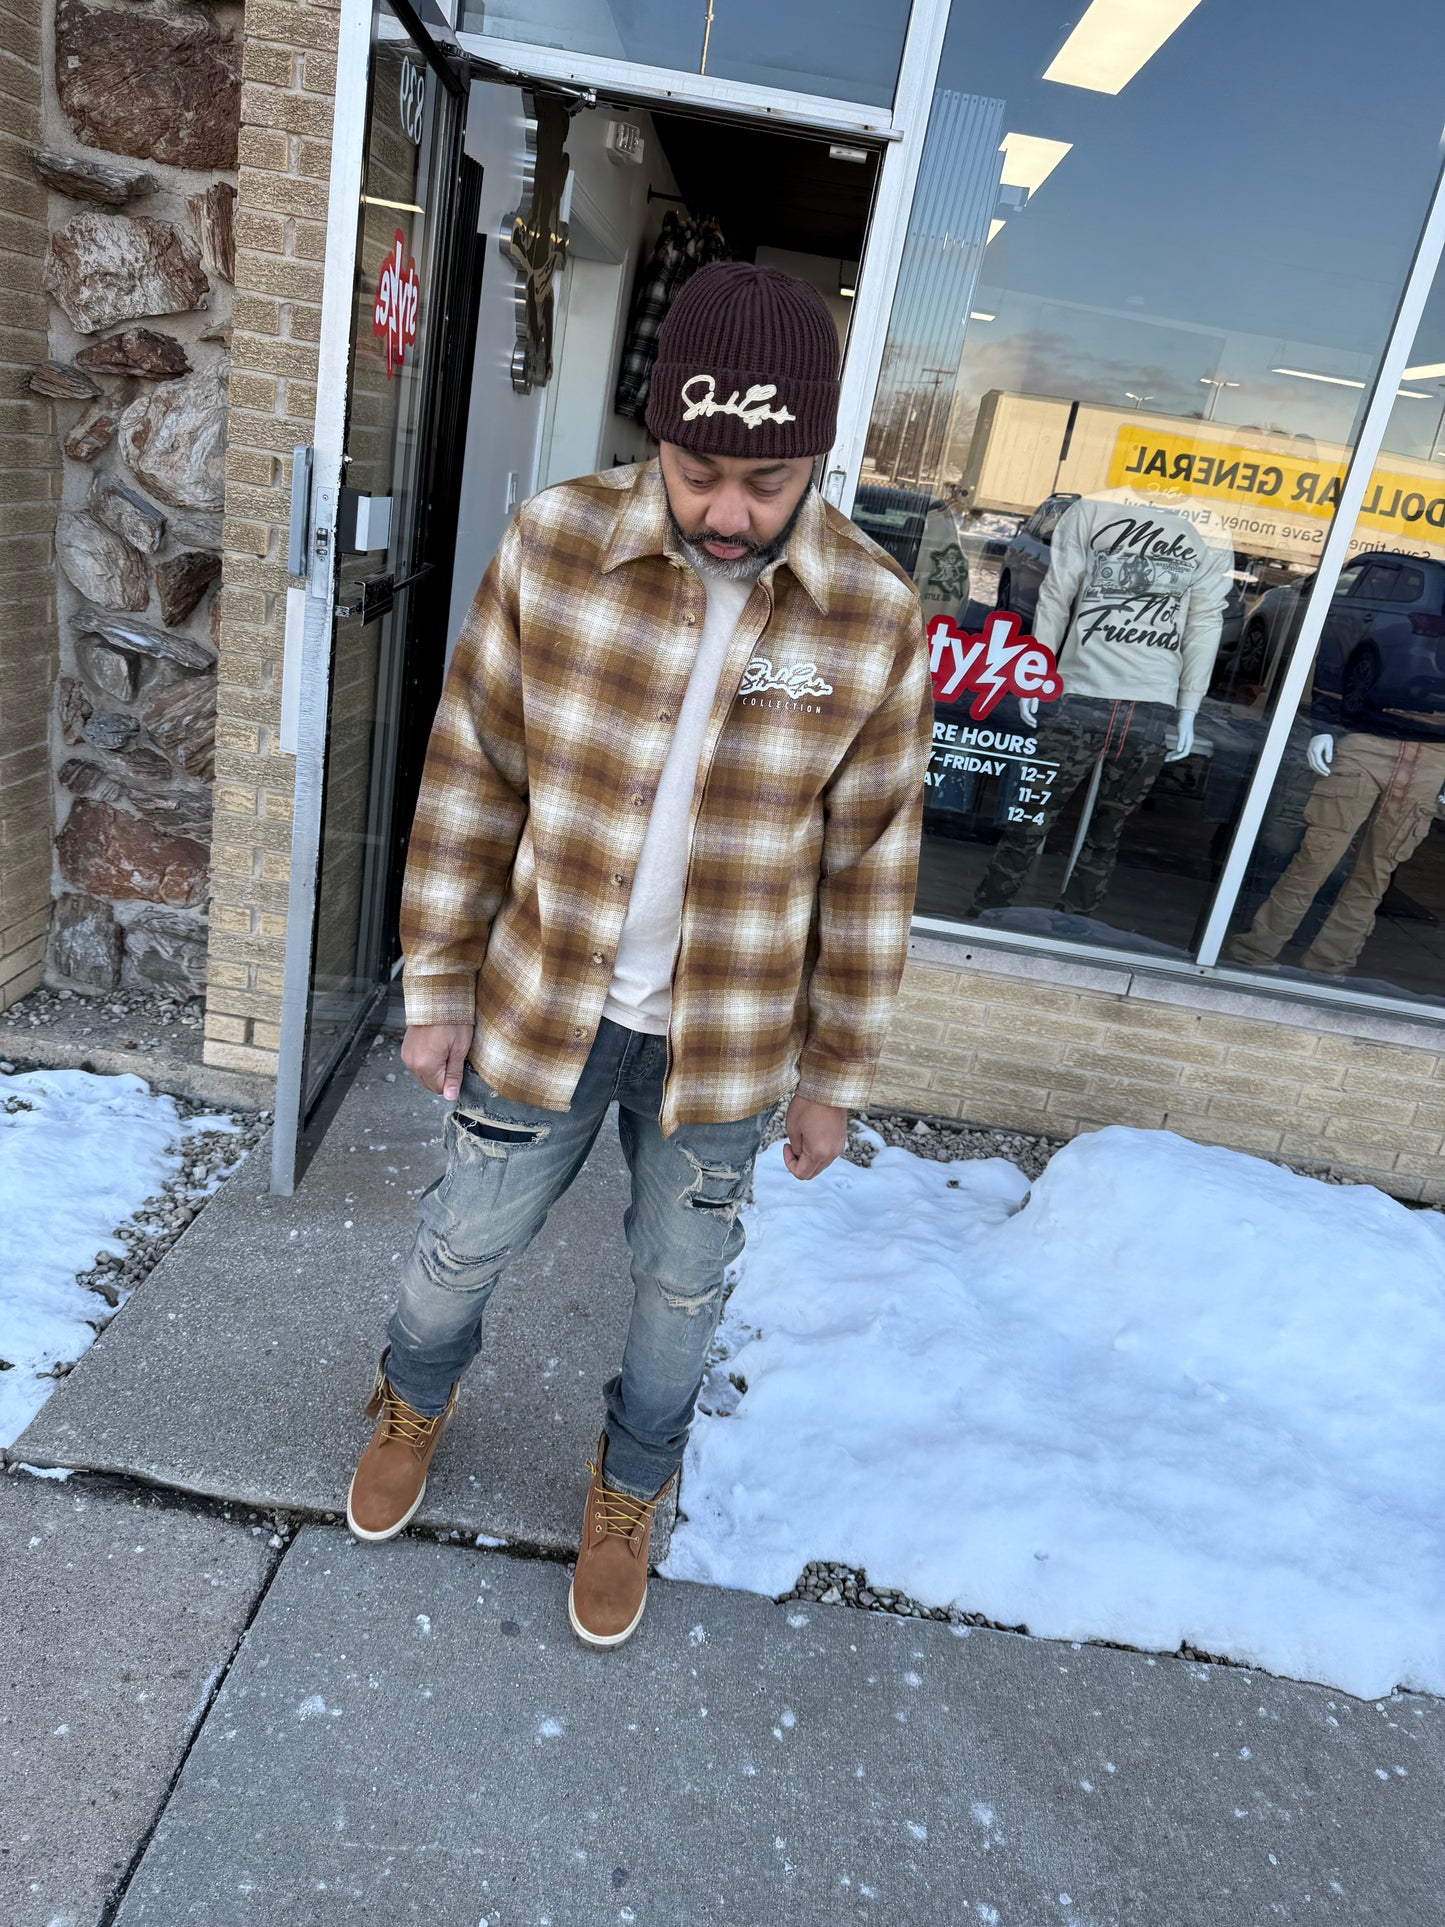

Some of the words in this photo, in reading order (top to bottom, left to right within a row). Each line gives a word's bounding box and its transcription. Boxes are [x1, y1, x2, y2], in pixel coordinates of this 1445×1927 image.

[1090, 519, 1198, 560] Make
[1121, 594, 1180, 626] Not
[742, 697, 822, 714] COLLECTION
[960, 727, 1038, 755] HOURS
[1020, 766, 1057, 785] 12-7
[1018, 787, 1052, 806] 11-7
[1007, 806, 1045, 826] 12-4
